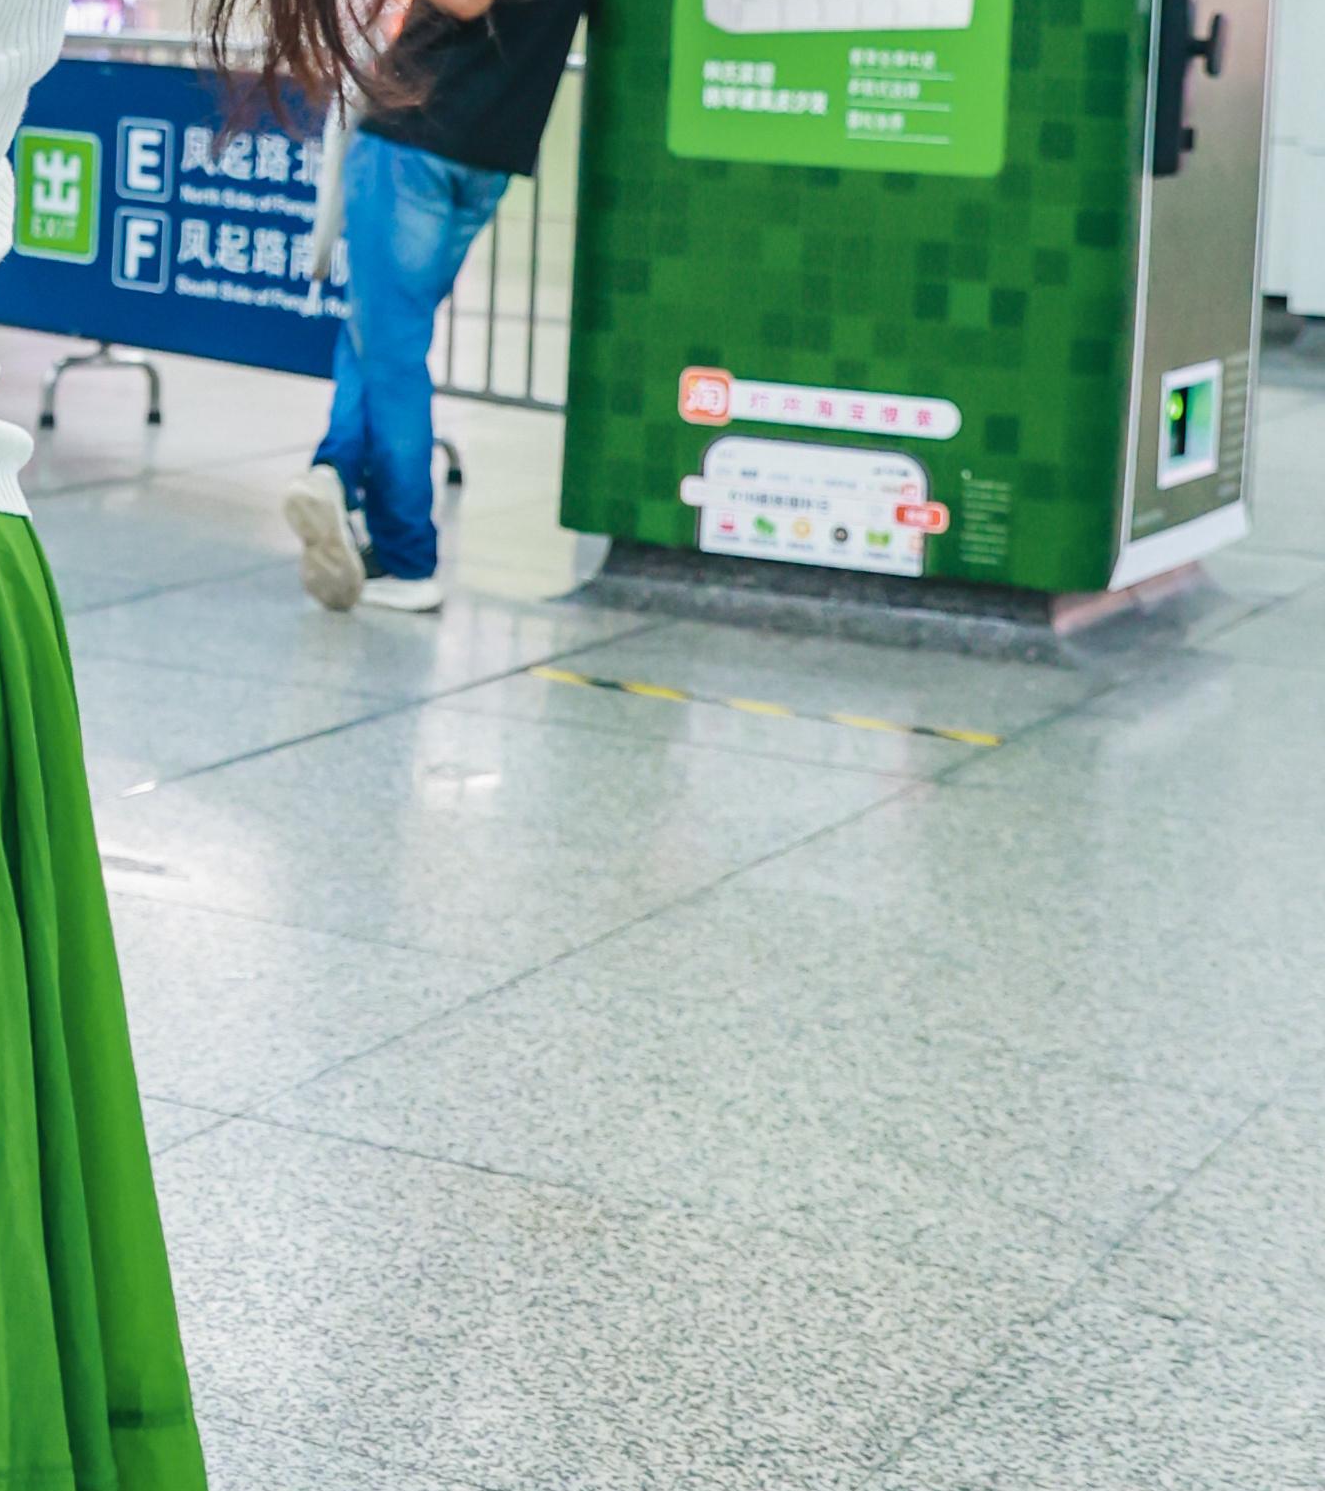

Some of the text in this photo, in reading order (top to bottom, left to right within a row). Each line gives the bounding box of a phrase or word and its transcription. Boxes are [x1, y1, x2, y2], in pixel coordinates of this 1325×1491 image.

[33, 149, 81, 213] 出
[127, 128, 162, 191] E
[124, 217, 158, 279] F
